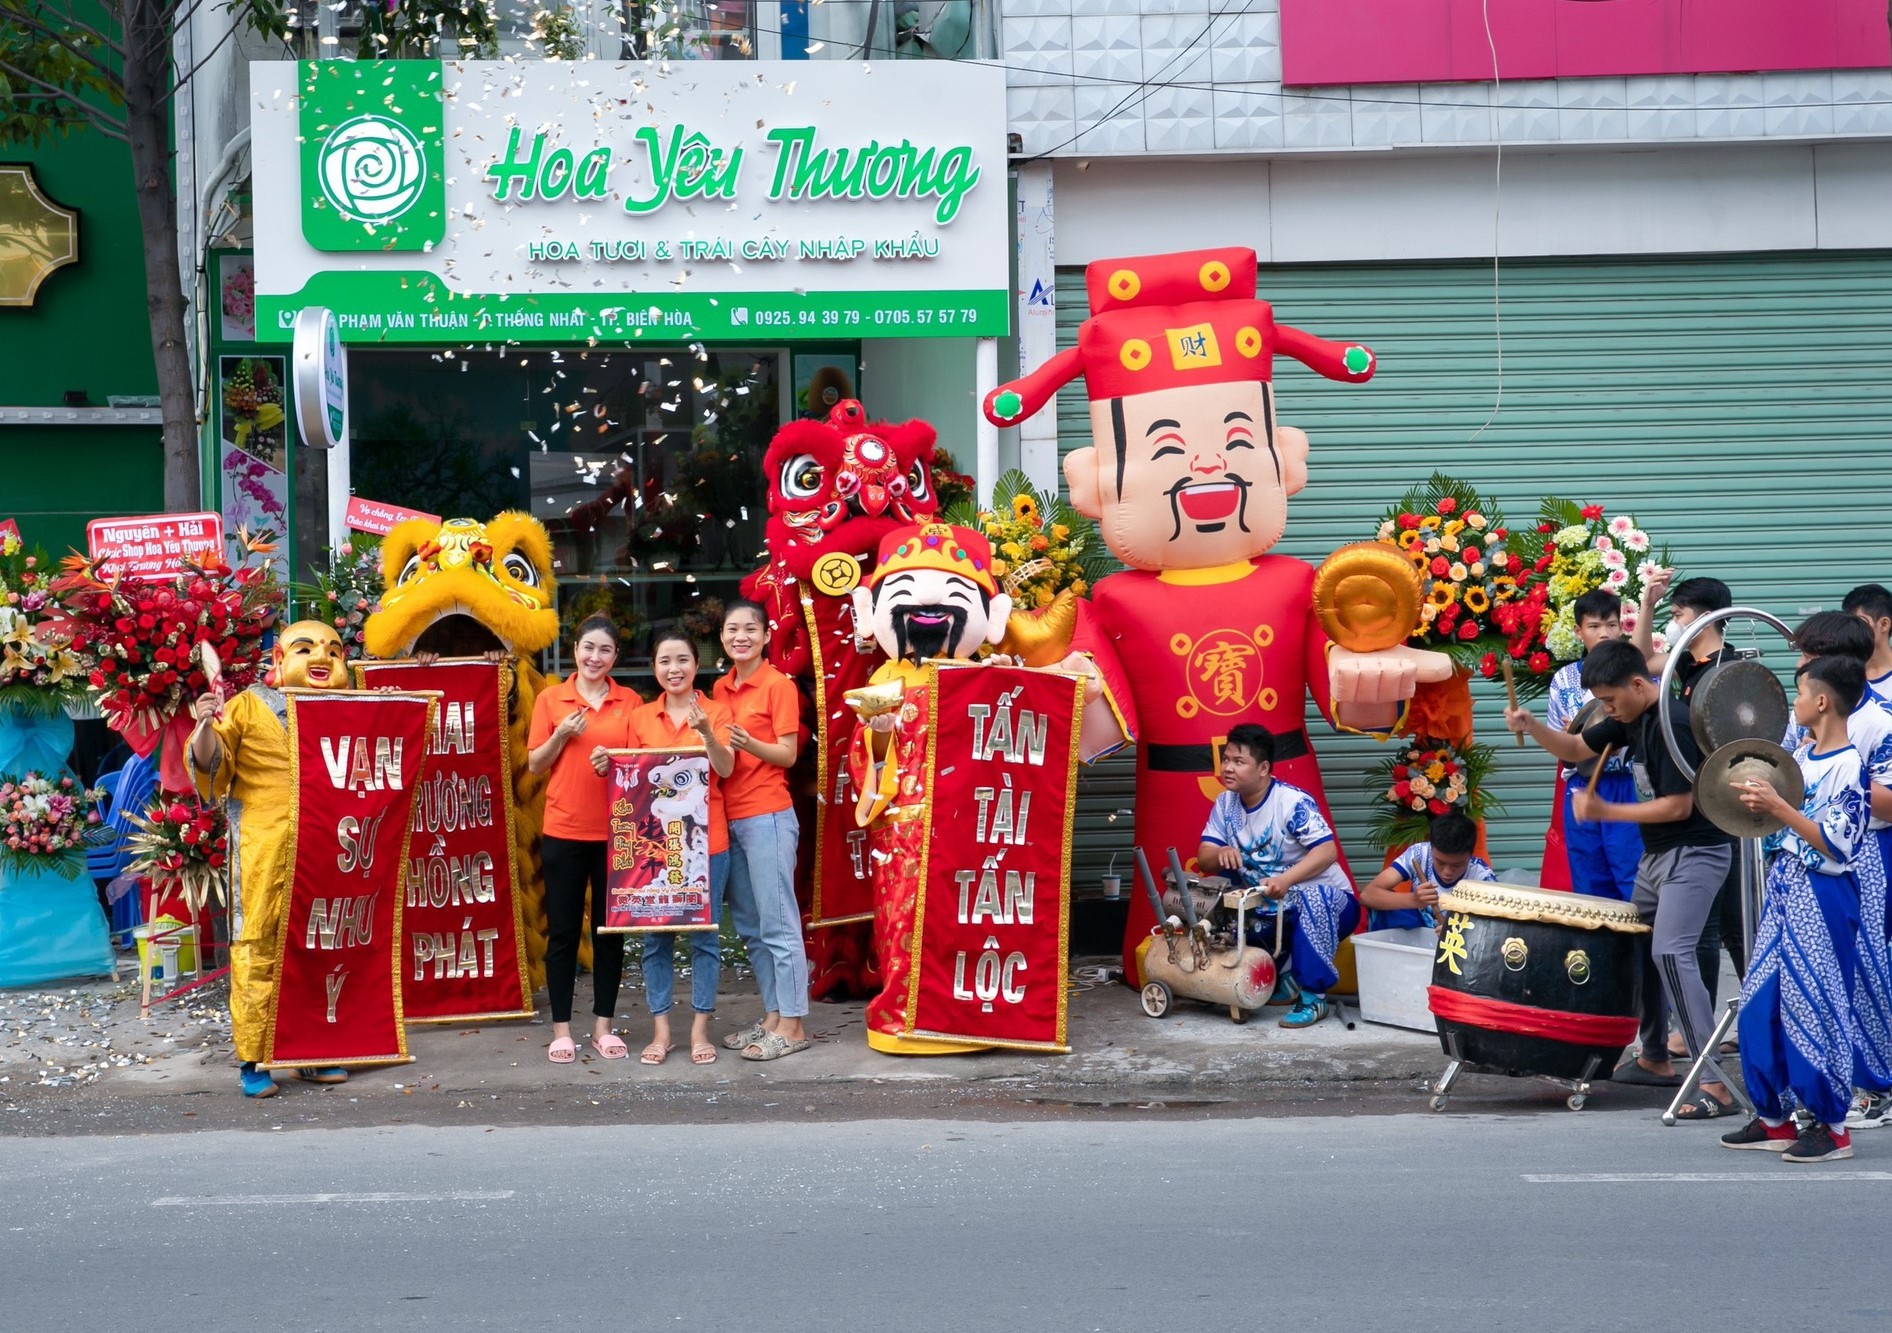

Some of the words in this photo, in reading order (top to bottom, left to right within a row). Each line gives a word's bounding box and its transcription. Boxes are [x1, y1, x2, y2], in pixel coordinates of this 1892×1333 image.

[486, 125, 612, 199] Hoa
[624, 123, 744, 213] Yêu
[766, 125, 983, 225] Thương
[528, 241, 580, 261] HOA
[592, 239, 646, 260] TƯƠI
[655, 241, 672, 259] &
[680, 236, 733, 260] TRÁI
[742, 235, 790, 260] CÂY
[799, 235, 865, 260] NHẬP
[874, 230, 940, 257] KHẨU
[339, 313, 381, 331] PHẠM
[387, 311, 414, 328] VĂN
[420, 310, 468, 330] THUẬN
[496, 308, 544, 327] THỐNG
[626, 310, 658, 327] BIÊN
[664, 309, 693, 326] HÒA
[822, 310, 839, 325] 39
[844, 310, 860, 324] 79
[939, 309, 955, 323] 57
[961, 309, 977, 323] 79
[1180, 331, 1207, 358] 财
[103, 525, 160, 543] Nguyên
[178, 520, 203, 536] Hải
[122, 543, 143, 558] Shop
[145, 542, 162, 555] Hoa
[164, 540, 180, 554] Yêu
[1195, 641, 1255, 707] 寶
[426, 701, 475, 755] HAI
[968, 686, 1048, 766] TẤN
[320, 736, 403, 798] VẠN
[412, 769, 494, 832] RƯƠNG
[974, 772, 1032, 845] TÀI
[337, 805, 388, 878] SỰ
[405, 834, 496, 908] HỒNG
[954, 848, 1036, 925] TẤN
[306, 887, 379, 950] NHƯ
[411, 916, 498, 981] PHÁT
[1437, 912, 1475, 975] 英
[325, 963, 350, 1023] Ý
[953, 935, 1028, 1012] LỘC
